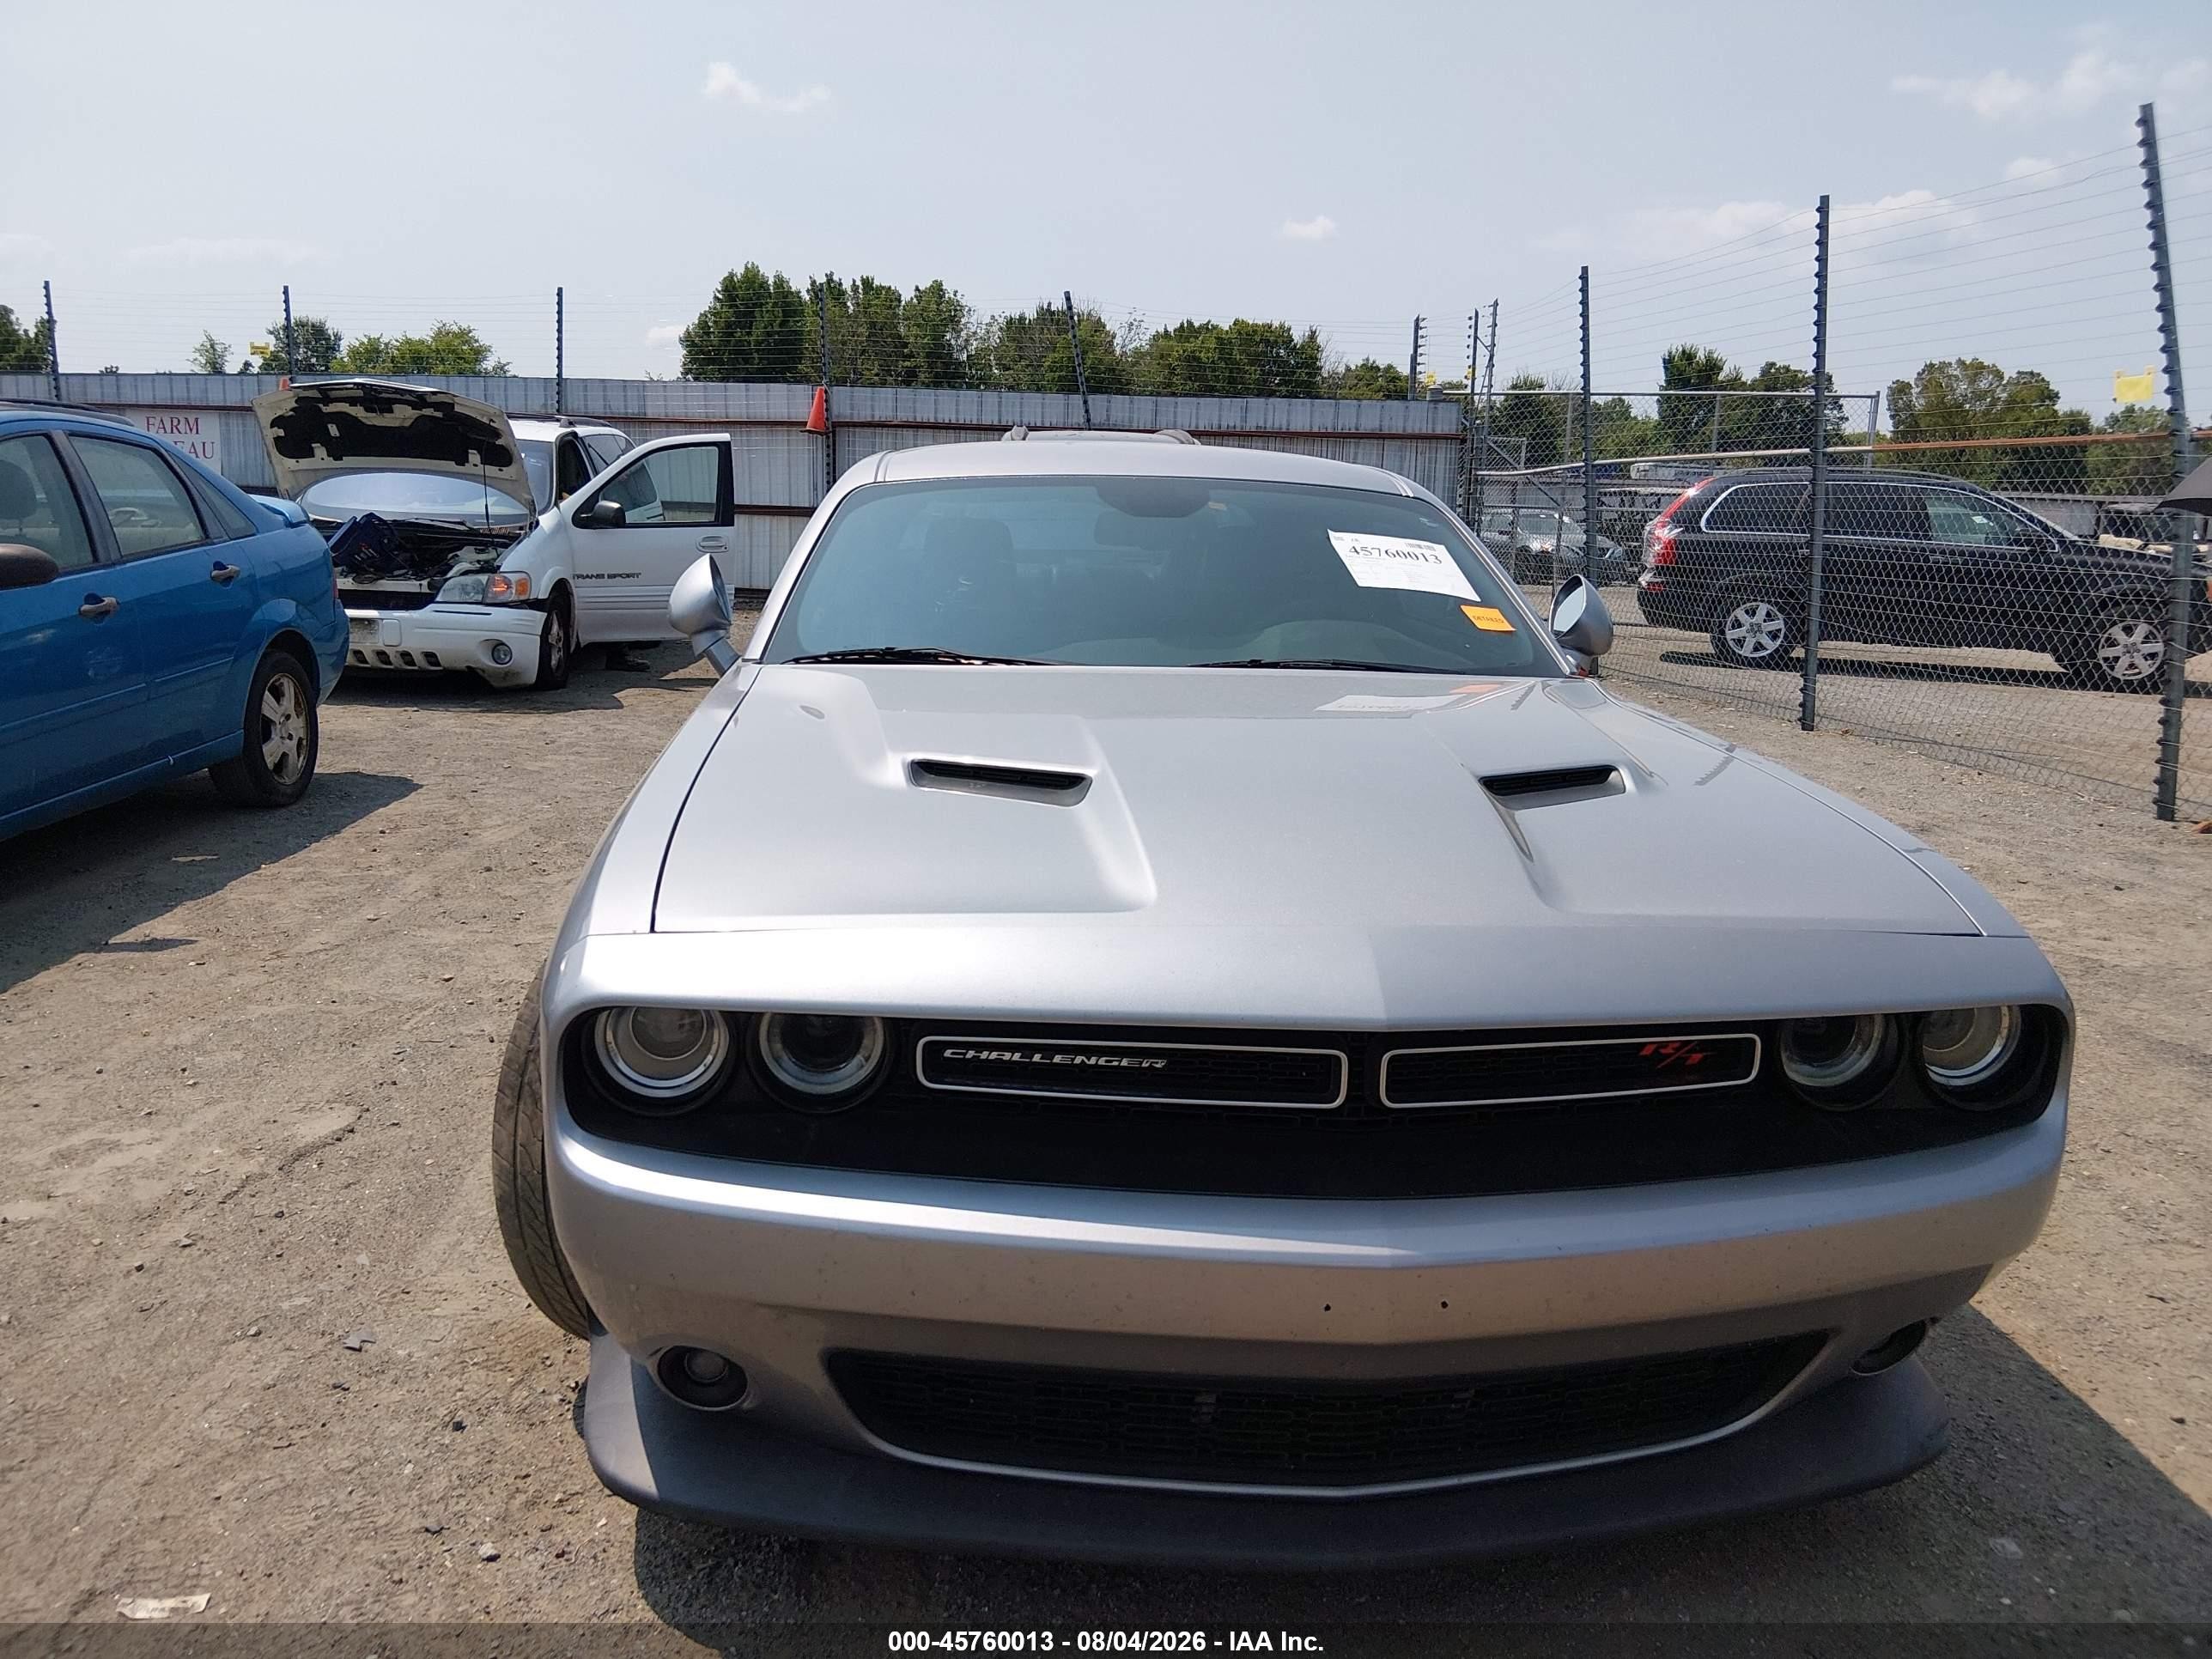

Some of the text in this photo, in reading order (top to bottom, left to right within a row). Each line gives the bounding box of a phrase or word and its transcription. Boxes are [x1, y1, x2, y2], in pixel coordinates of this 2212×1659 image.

[145, 416, 200, 434] FARM
[1348, 544, 1443, 565] 45760013
[943, 1048, 1167, 1068] CHALLENGER
[1637, 1040, 1711, 1069] R/T
